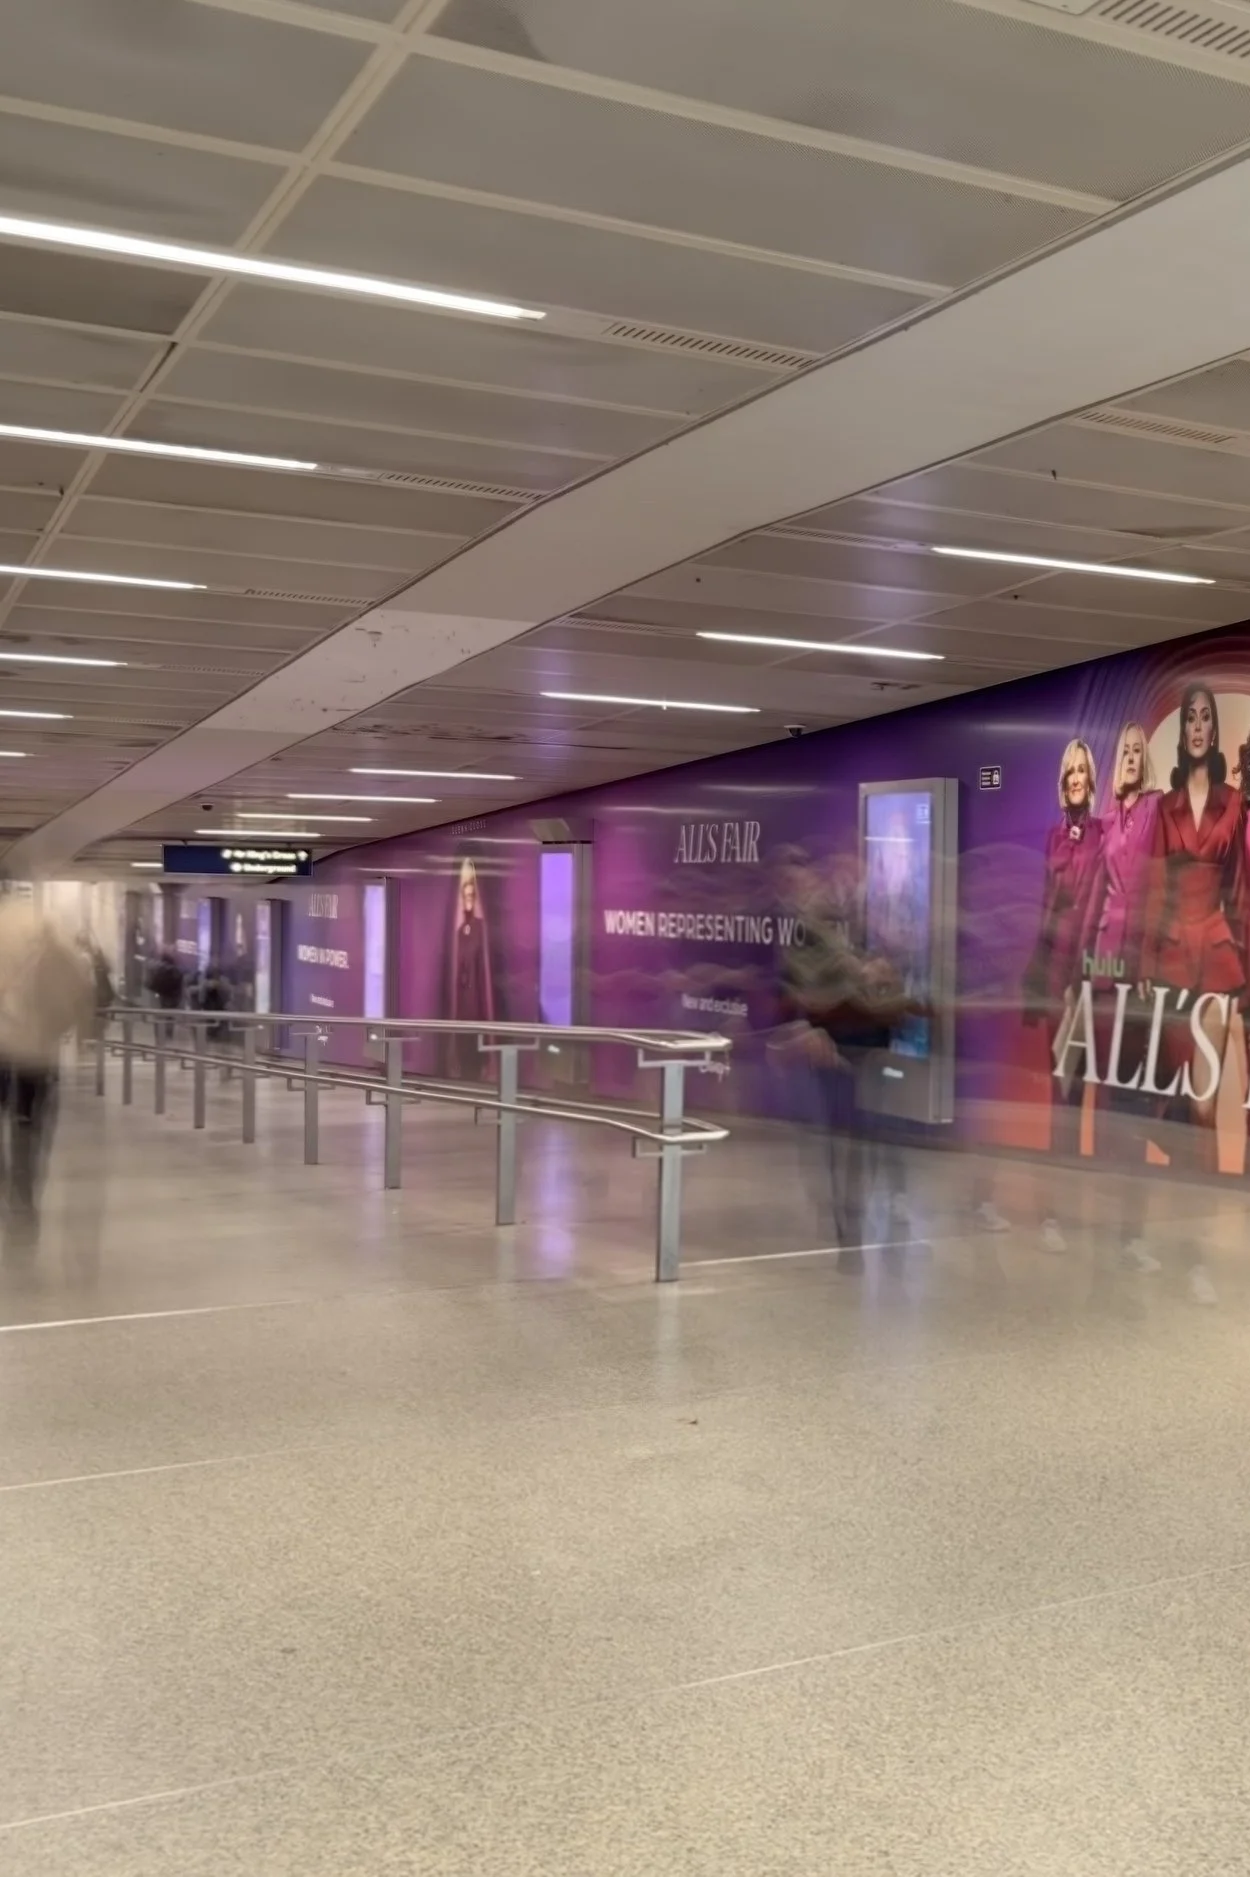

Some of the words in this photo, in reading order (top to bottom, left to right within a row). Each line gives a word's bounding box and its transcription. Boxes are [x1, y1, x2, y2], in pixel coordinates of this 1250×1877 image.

[674, 823, 718, 863] ALL'S
[721, 821, 760, 863] FAIR
[604, 910, 655, 937] WOMEN
[658, 912, 773, 945] REPRESENTING
[1083, 949, 1124, 977] hulu
[1053, 981, 1228, 1101] ALL'S
